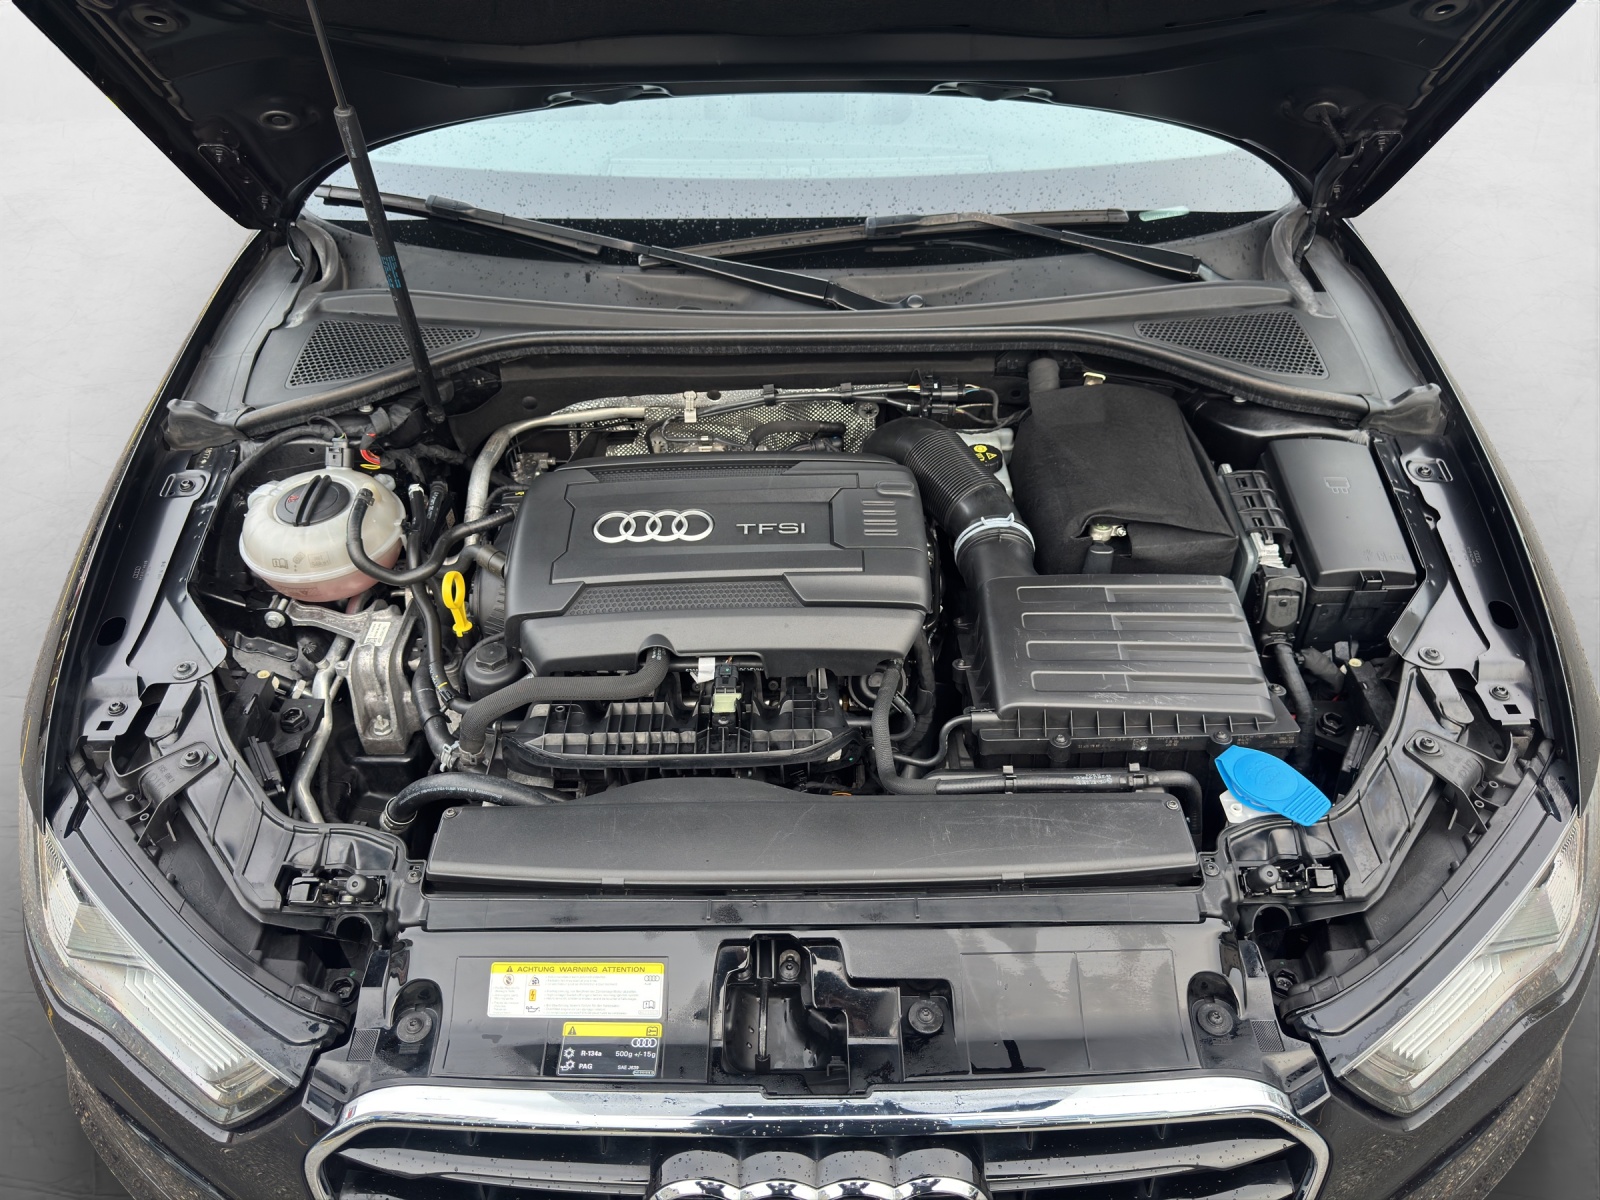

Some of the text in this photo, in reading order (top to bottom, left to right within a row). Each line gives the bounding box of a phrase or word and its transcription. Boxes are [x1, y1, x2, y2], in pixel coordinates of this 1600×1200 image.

[735, 522, 806, 535] TFSI
[615, 1050, 633, 1058] 500g
[643, 1051, 656, 1059] 15g
